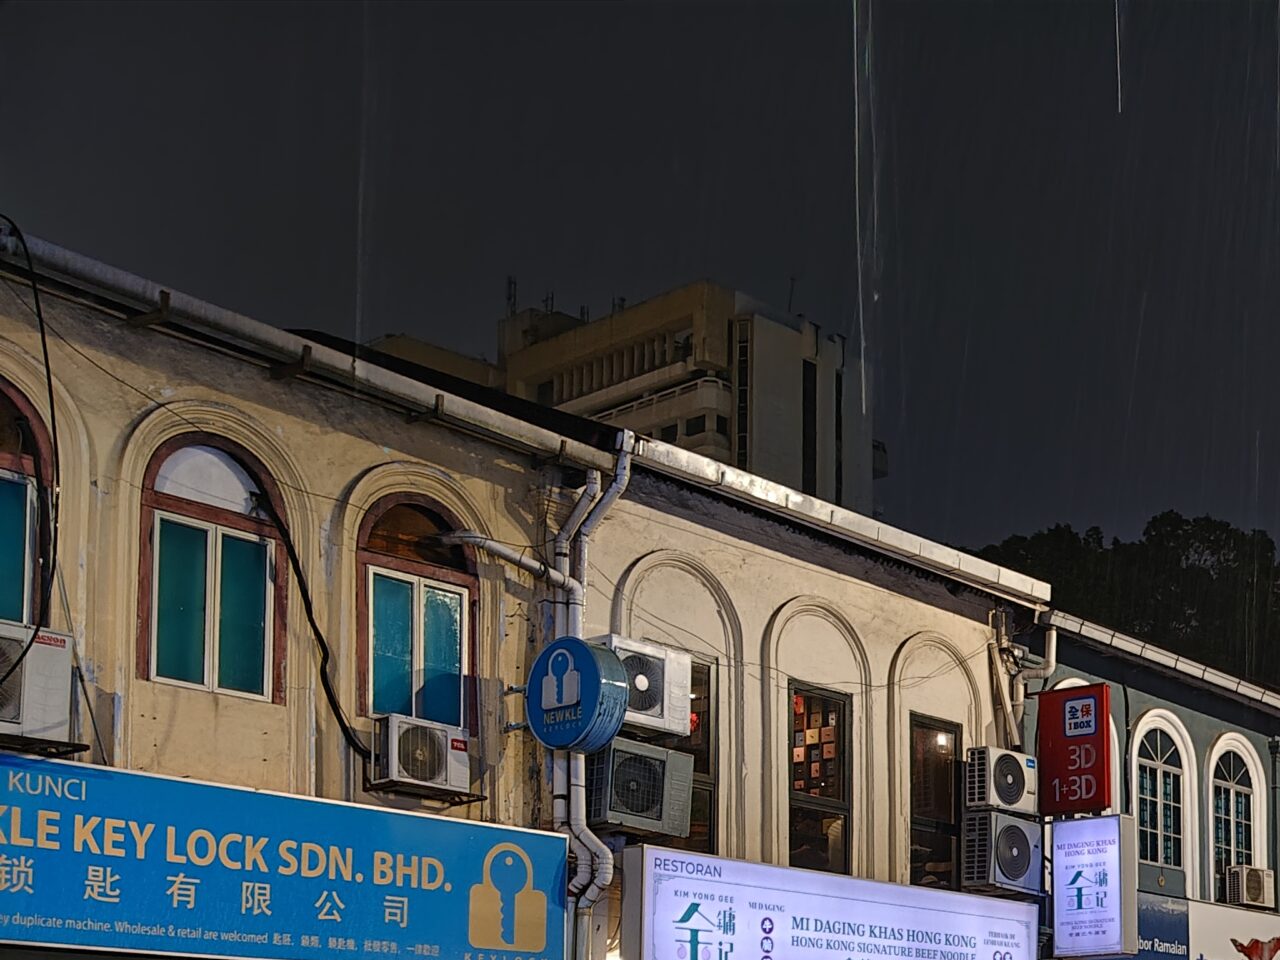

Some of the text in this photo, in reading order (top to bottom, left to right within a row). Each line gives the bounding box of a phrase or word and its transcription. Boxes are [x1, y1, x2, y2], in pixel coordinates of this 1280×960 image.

[544, 706, 582, 725] NEWKLE
[1068, 744, 1096, 770] 3D
[8, 770, 87, 800] KUNCI
[1052, 775, 1097, 802] 1+3D
[74, 814, 155, 860] KEY
[166, 825, 269, 873] LOCK
[278, 839, 364, 883] SDN.
[373, 851, 452, 892] BHD.
[654, 857, 722, 878] RESTORAN
[674, 889, 689, 898] KIM
[693, 891, 715, 901] YONG
[11, 912, 63, 928] duplicate
[65, 918, 113, 932] machine.
[114, 921, 165, 937] Wholesale
[167, 925, 175, 936] &
[177, 927, 202, 939] retail
[203, 930, 218, 940] are
[220, 931, 269, 944] welcomed
[791, 916, 977, 949] MI DAGING KHAS HONG KONG
[791, 936, 823, 949] HONG
[826, 939, 855, 952] KONG
[857, 942, 913, 958] SIGNATURE
[915, 948, 938, 960] BEEF
[1153, 938, 1187, 955] Ramalan
